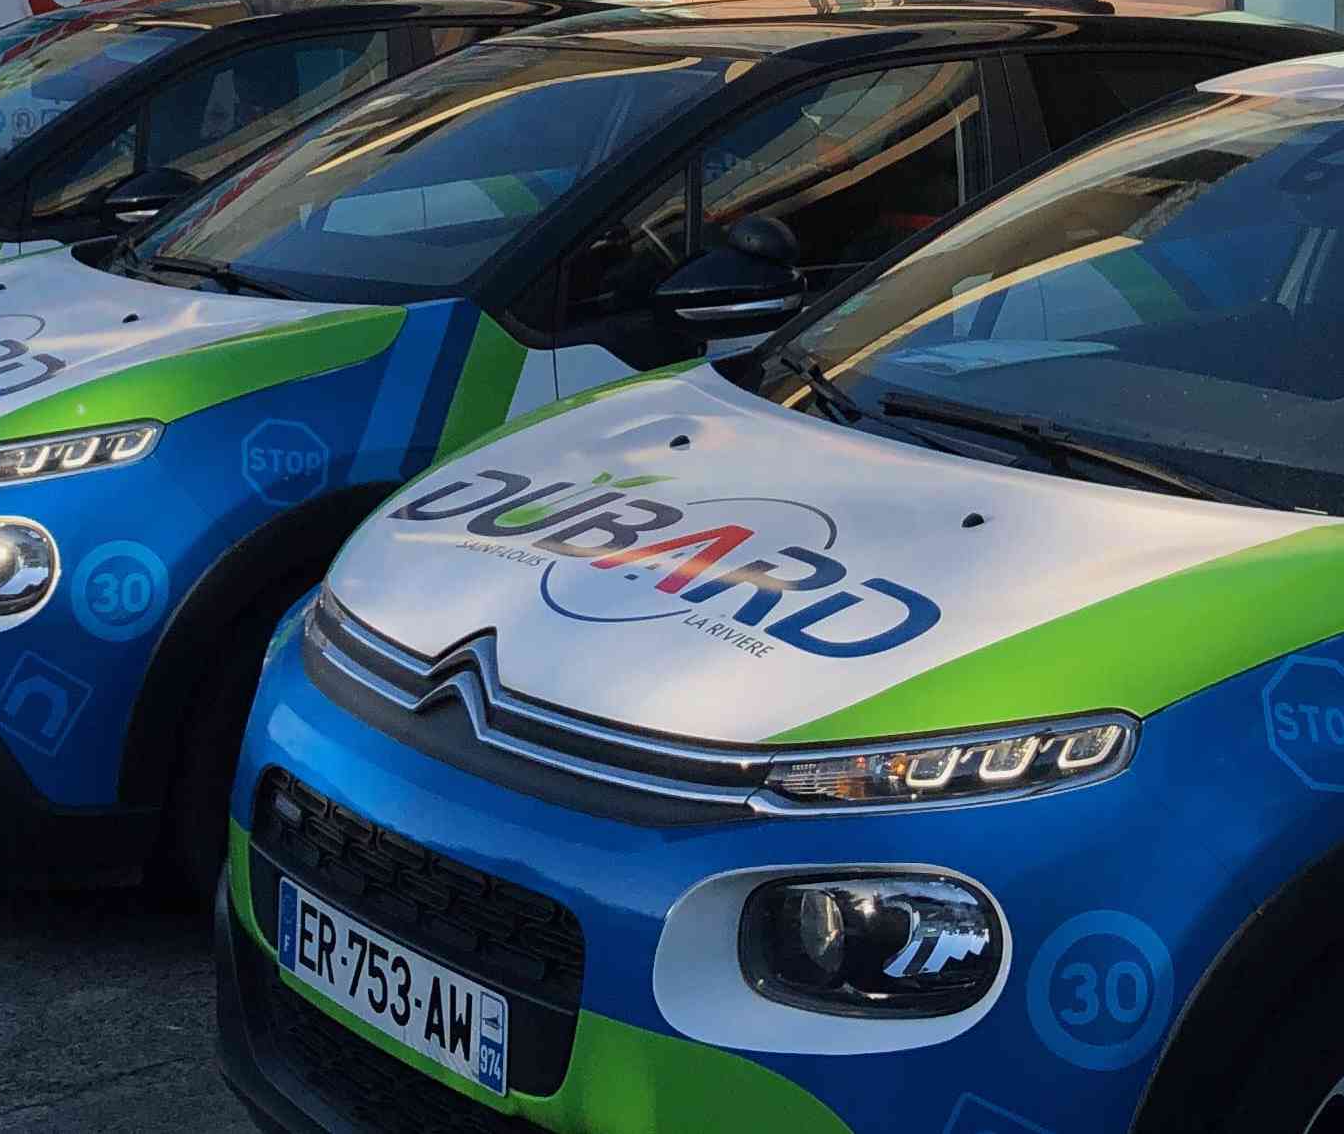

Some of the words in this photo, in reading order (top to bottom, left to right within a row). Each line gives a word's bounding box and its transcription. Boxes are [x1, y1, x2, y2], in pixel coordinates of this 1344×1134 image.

[249, 447, 321, 477] STOP
[386, 469, 942, 659] DUBARD
[92, 571, 149, 614] 30
[683, 613, 704, 632] LA
[706, 622, 775, 659] RIVIERE
[298, 899, 474, 1063] ER-753-AW
[1059, 959, 1147, 1026] 30
[480, 1044, 503, 1082] 974
